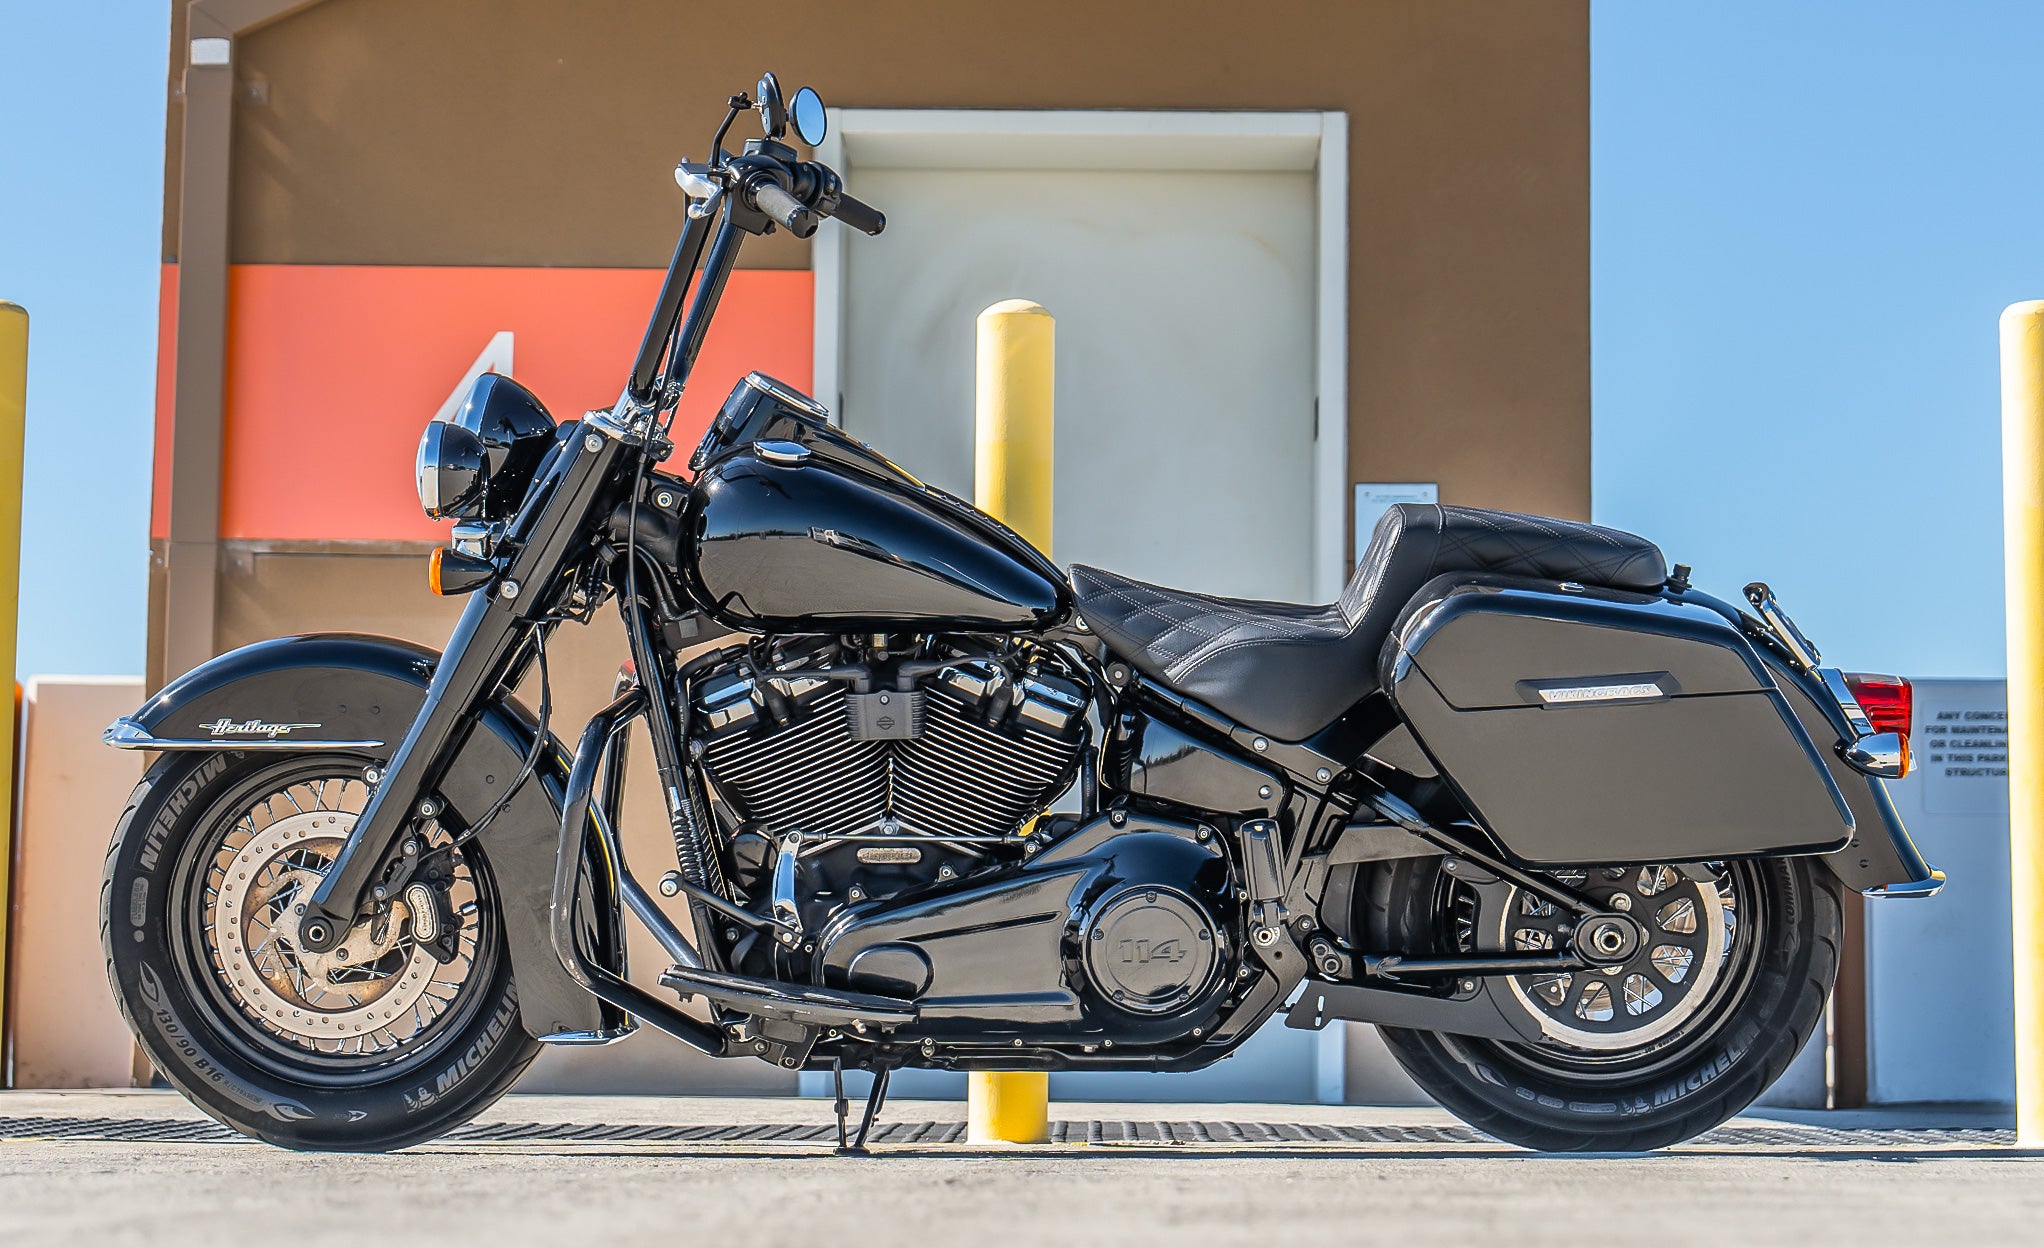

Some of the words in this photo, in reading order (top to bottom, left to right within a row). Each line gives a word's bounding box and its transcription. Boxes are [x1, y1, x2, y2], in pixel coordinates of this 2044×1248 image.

[1964, 711, 2007, 721] CONCE
[210, 718, 292, 738] Heritage
[1925, 725, 1947, 734] FOR
[1929, 739, 1946, 748] OR
[1930, 753, 1943, 762] IN
[1948, 753, 1973, 762] THIS
[140, 753, 228, 871] MICHELIN
[1119, 939, 1188, 964] 114
[156, 1009, 197, 1057] 130/90
[1654, 1020, 1761, 1106] MICHELIN
